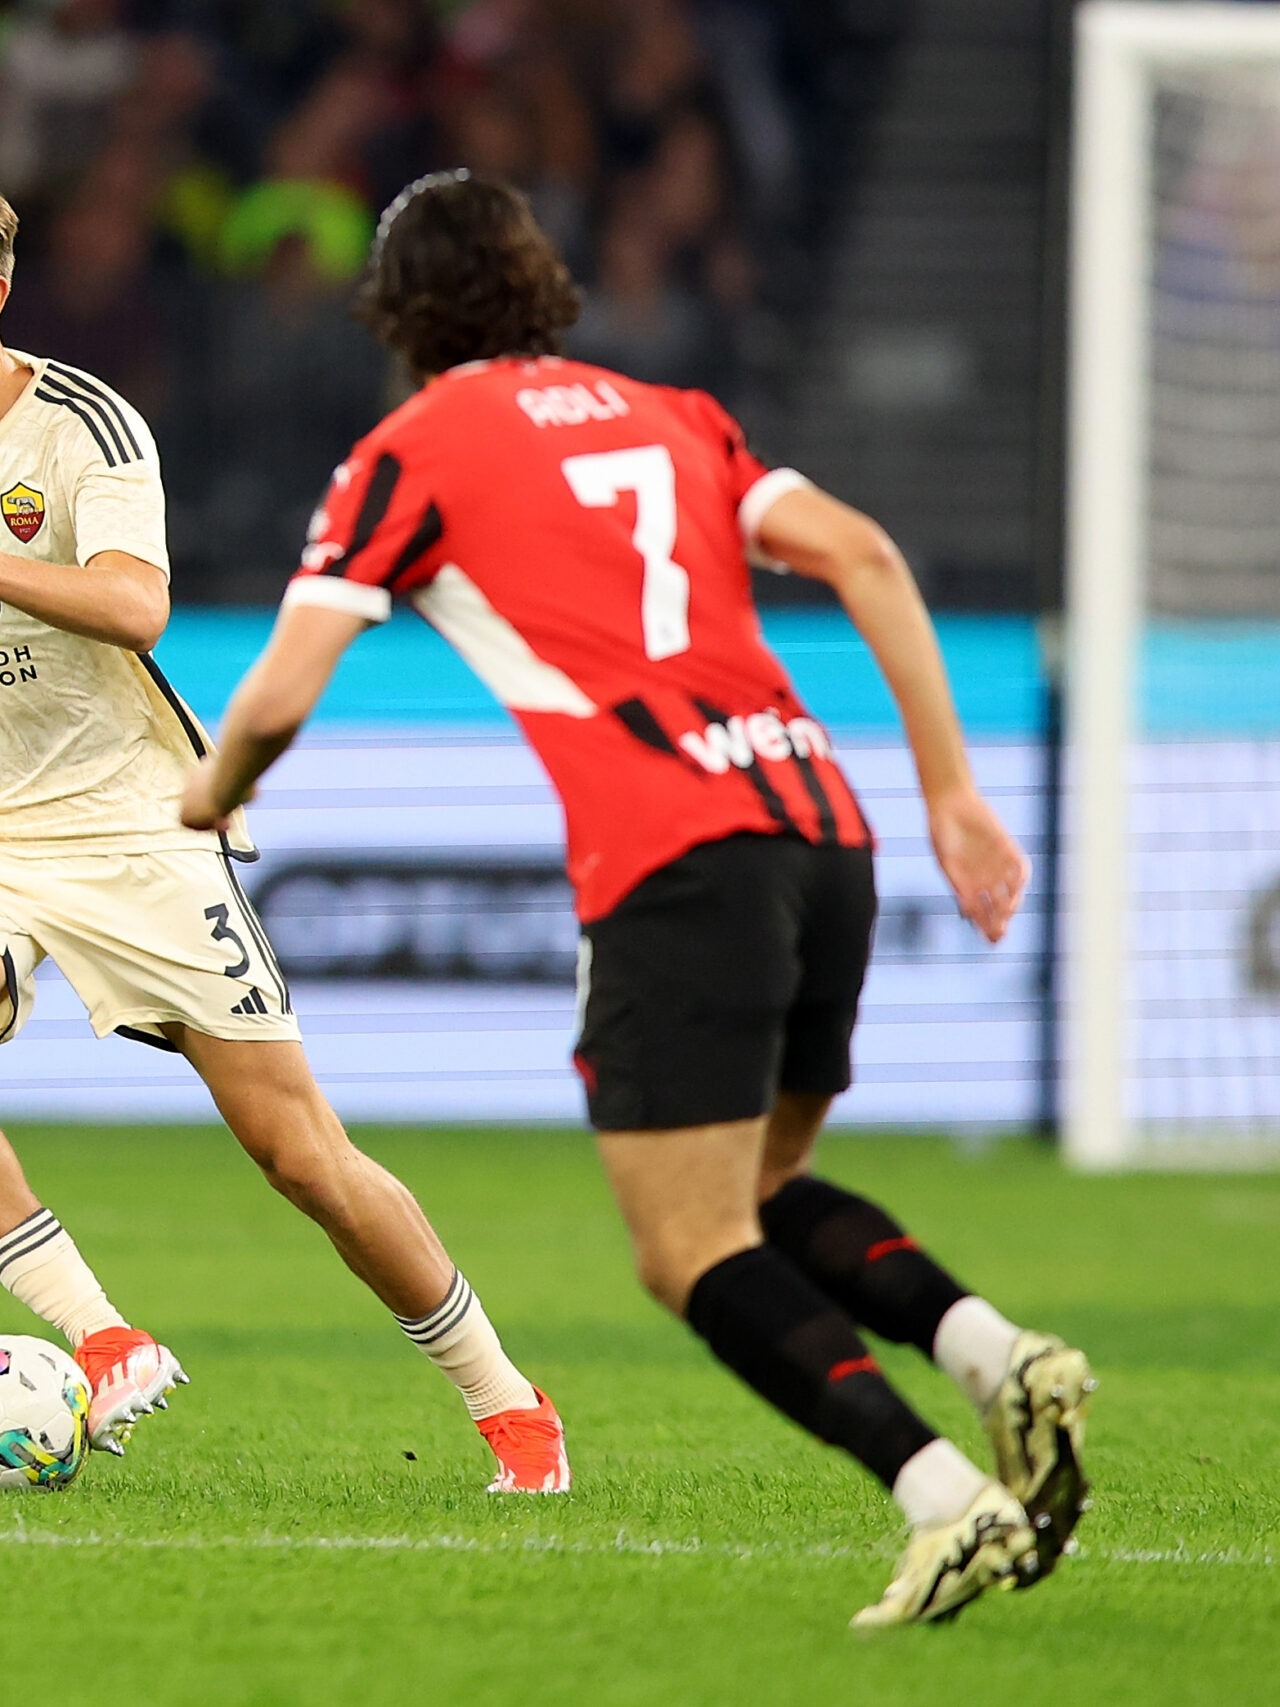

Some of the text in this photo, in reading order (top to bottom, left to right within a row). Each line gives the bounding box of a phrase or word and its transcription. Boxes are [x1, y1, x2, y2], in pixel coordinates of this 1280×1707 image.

[10, 516, 39, 526] ROMA
[560, 443, 692, 662] 7
[203, 902, 250, 979] 3
